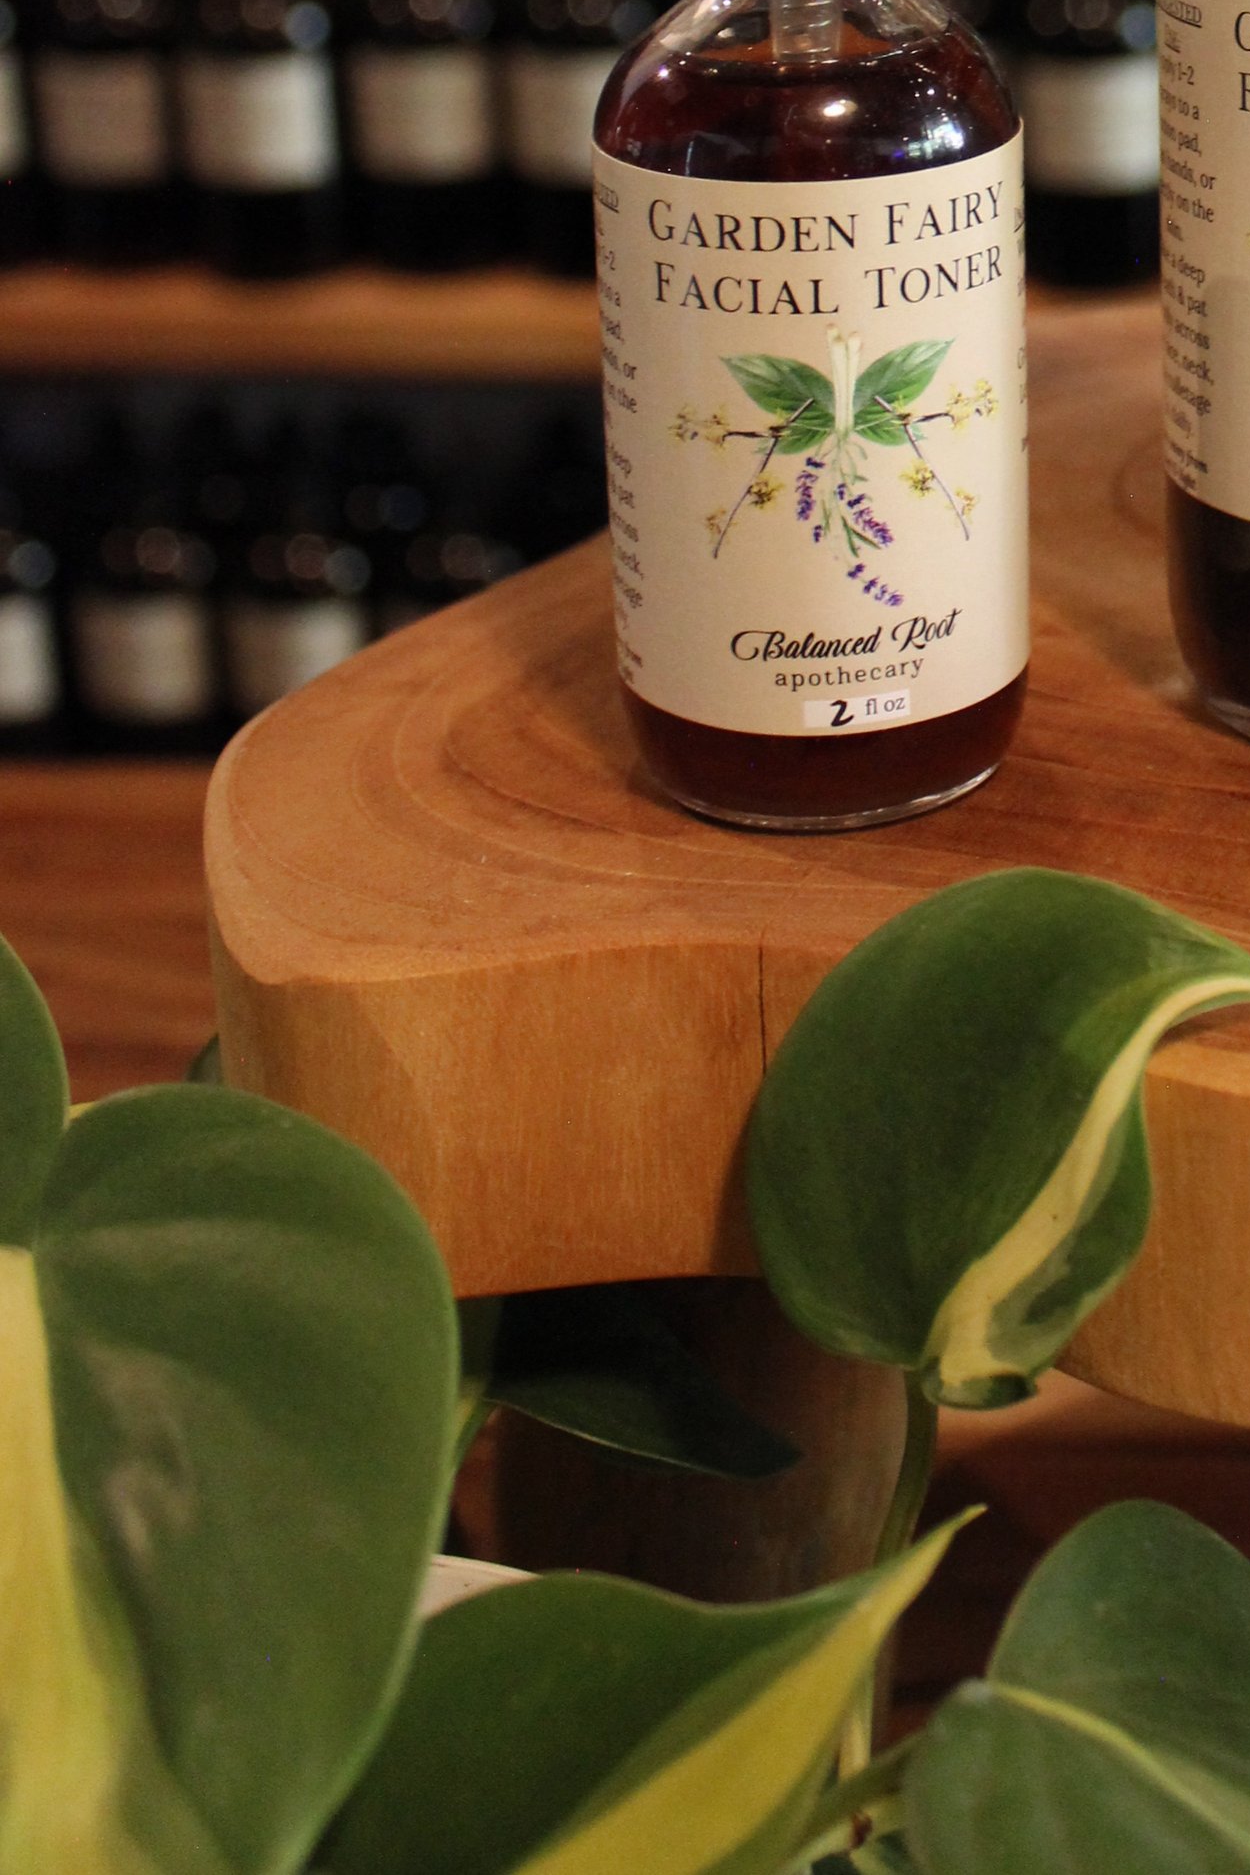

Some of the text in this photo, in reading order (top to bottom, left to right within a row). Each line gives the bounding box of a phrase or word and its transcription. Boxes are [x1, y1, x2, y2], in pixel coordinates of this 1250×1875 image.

[1199, 172, 1217, 190] or
[648, 199, 859, 253] GARDEN
[884, 181, 1003, 244] FAIRY
[1192, 198, 1215, 223] the
[654, 245, 1003, 315] FACIAL TONER
[731, 608, 963, 662] Balanced Root
[774, 657, 925, 692] apothecary
[830, 696, 905, 727] 2 fl oz
